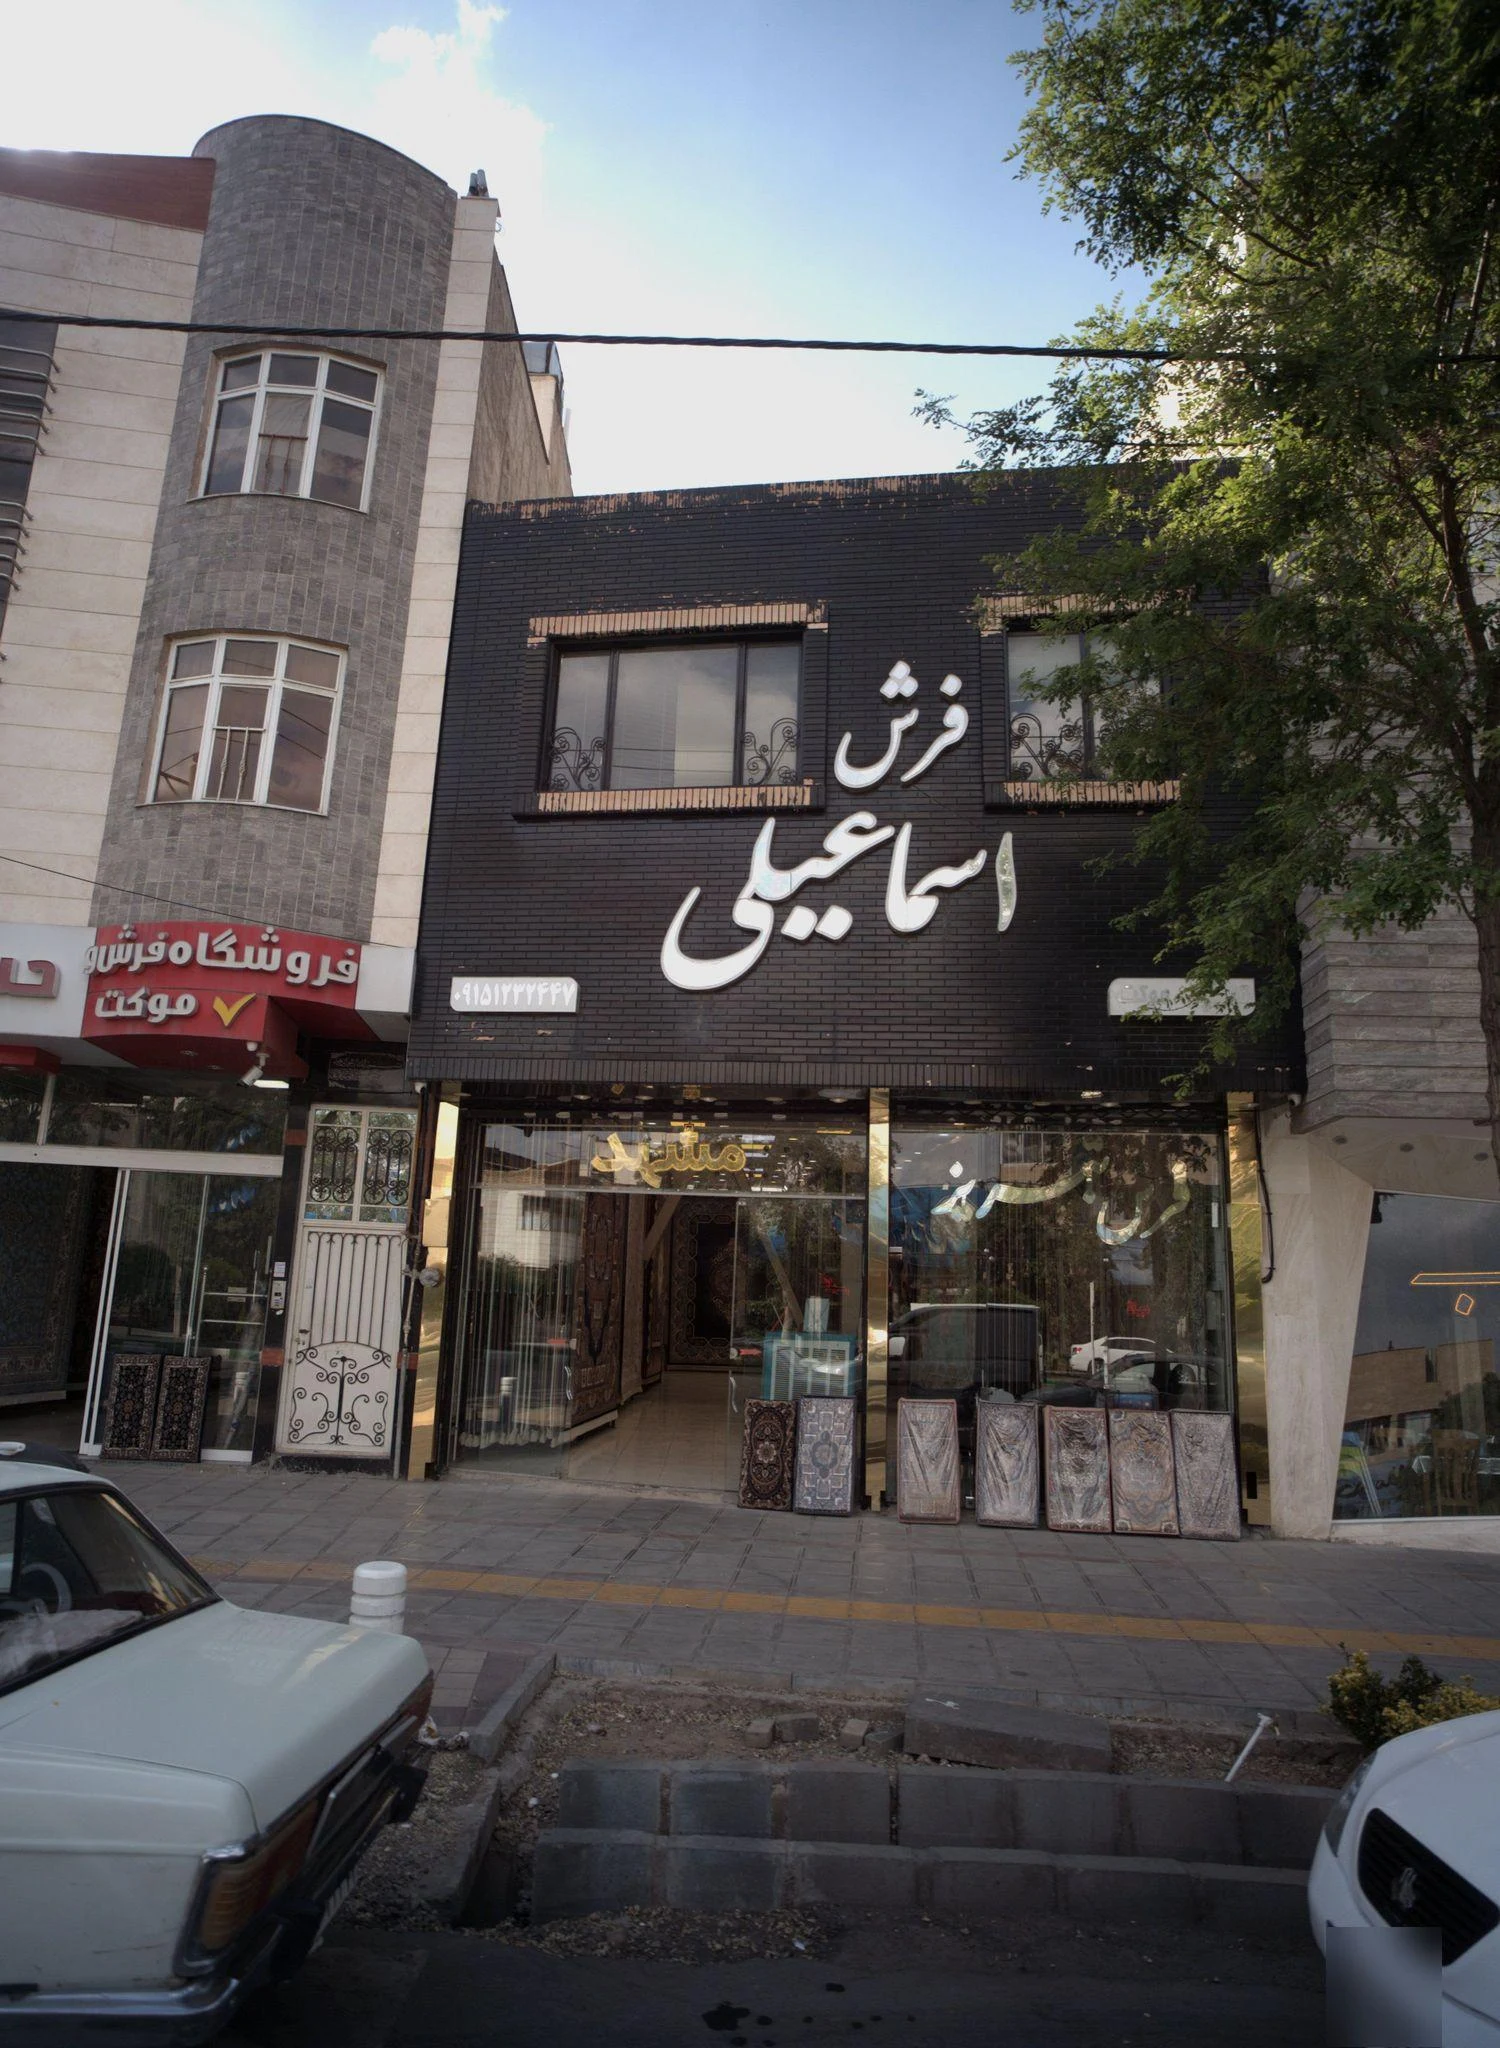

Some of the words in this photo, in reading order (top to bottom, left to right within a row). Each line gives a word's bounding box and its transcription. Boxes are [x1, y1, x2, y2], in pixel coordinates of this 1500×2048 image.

[834, 660, 969, 788] فرش
[660, 811, 1017, 990] اسماعیلی
[99, 924, 169, 974] فرش
[168, 926, 360, 987] فروشگاه
[94, 986, 197, 1023] موکت
[454, 982, 576, 1006] ۰۹۱۵۱۲۳۲۴۴۷
